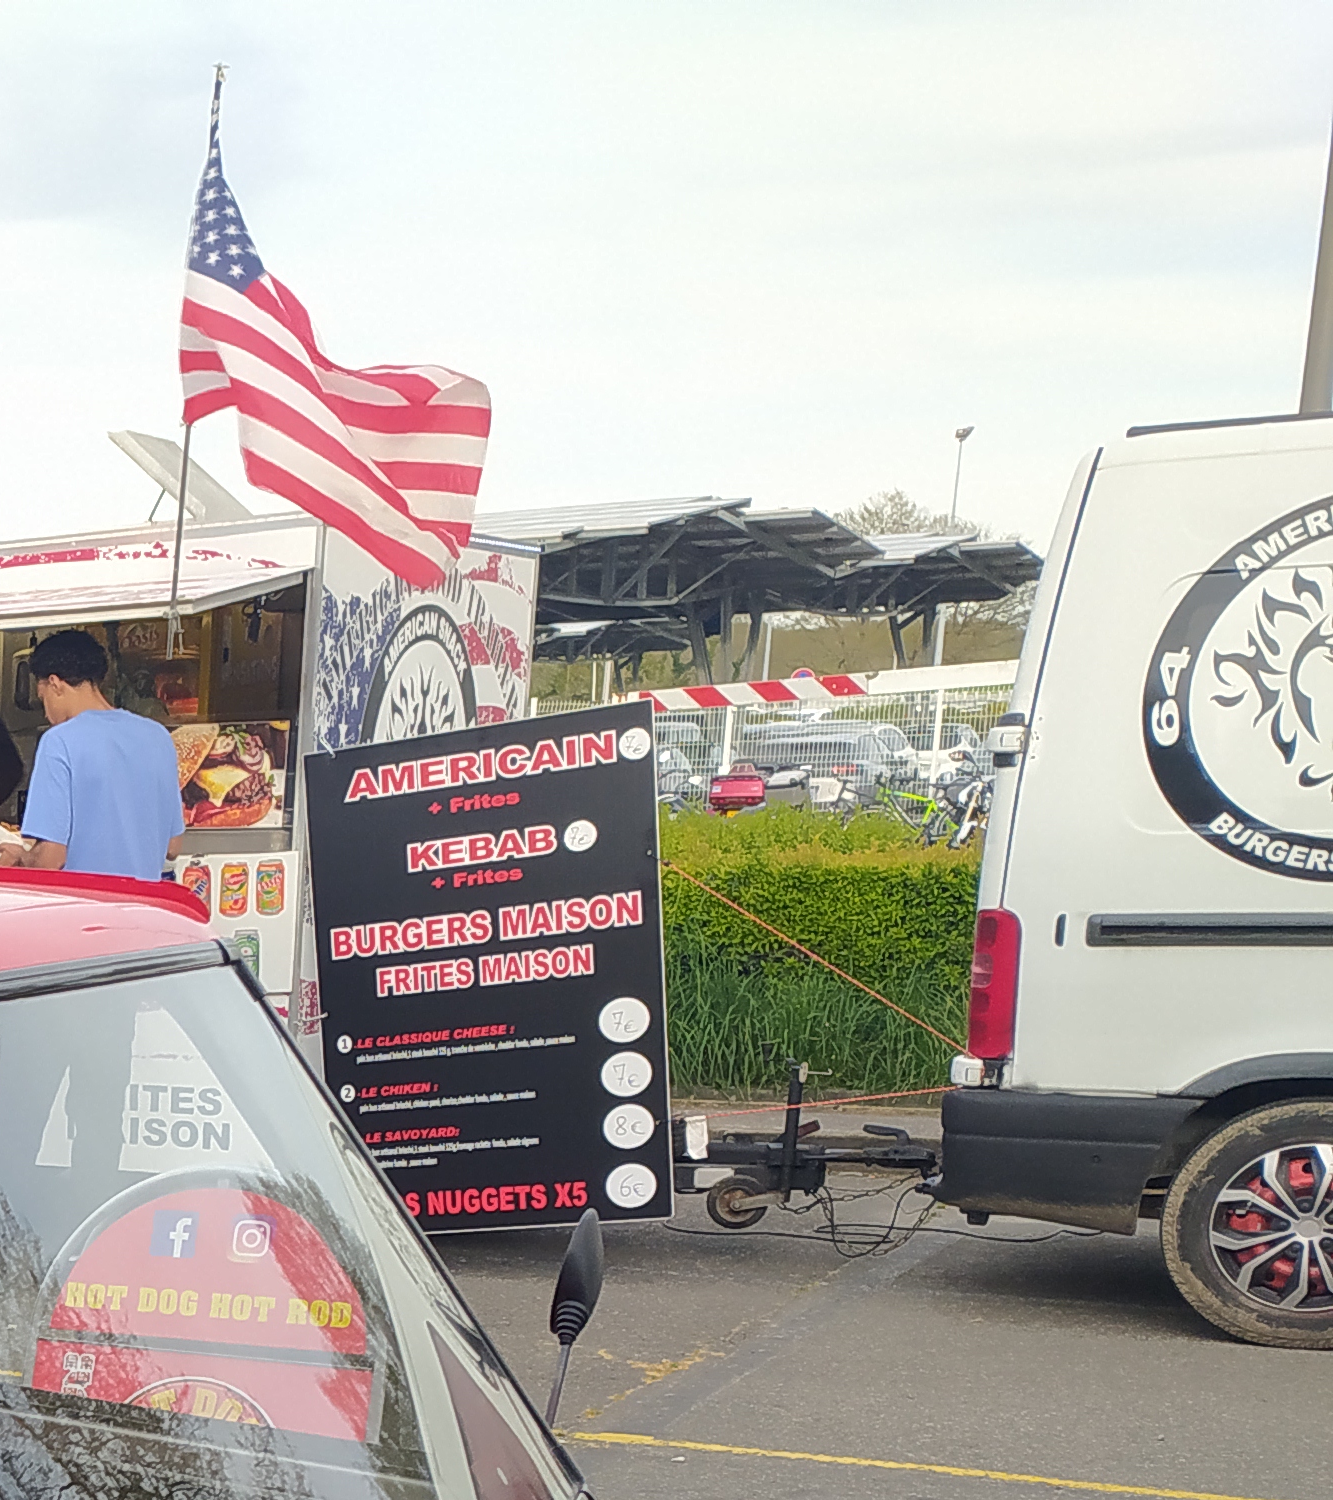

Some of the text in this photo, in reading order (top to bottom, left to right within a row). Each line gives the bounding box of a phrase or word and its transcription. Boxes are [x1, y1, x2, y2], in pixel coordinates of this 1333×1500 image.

[384, 611, 467, 682] AMERICAN SNACK
[1151, 646, 1192, 748] 64
[343, 730, 618, 803] AMERICAIN
[449, 792, 521, 813] Frites
[407, 824, 557, 873] KEBAB
[453, 868, 523, 888] Frites
[330, 890, 643, 961] BURGERS MAISON
[376, 944, 594, 997] FRITES MAISON
[376, 1030, 450, 1047] CLASSIQUE
[453, 1024, 507, 1040] CHEESE
[612, 1011, 638, 1034] 7€
[380, 1082, 432, 1096] CHIKEN
[613, 1063, 640, 1088] 7€
[129, 1083, 223, 1116] ITES
[127, 1117, 231, 1151] ISON
[365, 1126, 460, 1143] LE SAVOYARD:
[427, 1182, 548, 1216] NUGGETS
[554, 1180, 587, 1207] X5
[620, 1173, 646, 1198] 6€
[64, 1282, 352, 1328] HOT DOG HOT ROD
